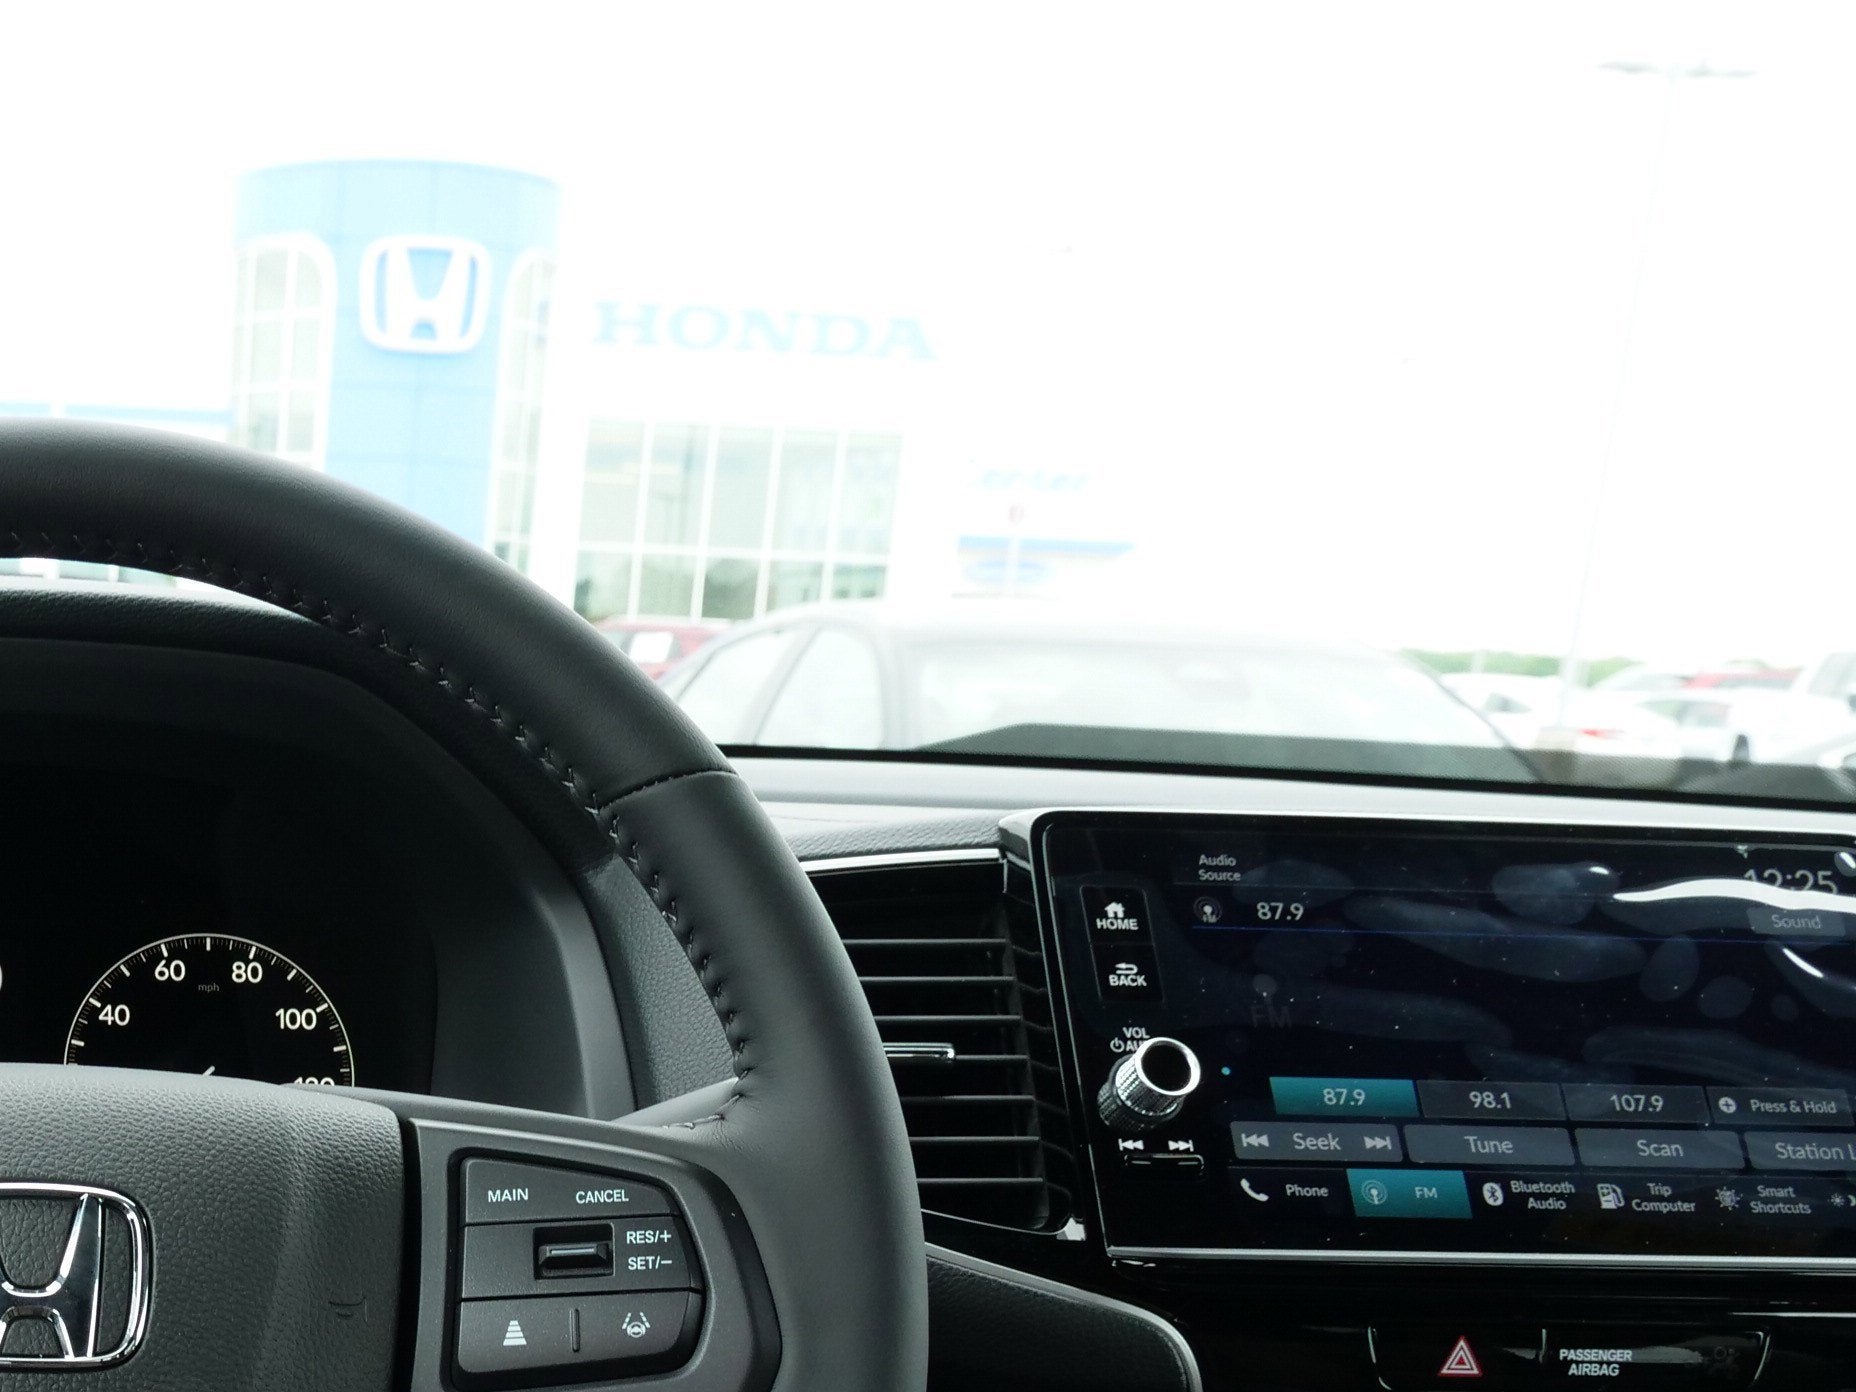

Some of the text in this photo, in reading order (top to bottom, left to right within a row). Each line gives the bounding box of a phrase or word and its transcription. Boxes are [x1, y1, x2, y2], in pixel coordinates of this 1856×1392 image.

[592, 299, 940, 362] HONDA
[1198, 853, 1237, 867] Audio
[1198, 868, 1242, 882] Source
[1256, 901, 1305, 921] 87.9
[1096, 917, 1139, 931] HOME
[1771, 914, 1822, 930] Sound
[154, 959, 185, 982] 60
[231, 961, 263, 984] 80
[198, 983, 220, 993] mph
[1108, 974, 1147, 988] BACK
[99, 1004, 130, 1027] 40
[275, 1008, 317, 1031] 100
[1122, 1026, 1150, 1039] VOL
[1323, 1089, 1365, 1107] 87.9
[1469, 1092, 1511, 1109] 98.1
[1610, 1095, 1663, 1113] 107.9
[1750, 1099, 1837, 1114] Press & Hold
[1292, 1132, 1341, 1151] Seek
[1464, 1136, 1513, 1154] Tune
[1637, 1139, 1683, 1157] Scan
[1775, 1142, 1845, 1160] Station
[1286, 1184, 1329, 1198] Phone
[1415, 1187, 1438, 1199] FM
[1510, 1180, 1575, 1194] Bluetooth
[1647, 1182, 1672, 1198] Trip
[1757, 1184, 1796, 1198] Smart
[487, 1188, 529, 1203] MAIN
[575, 1189, 630, 1204] CANCEL
[1528, 1197, 1566, 1211] Audio
[1632, 1199, 1696, 1214] Computer
[1750, 1200, 1812, 1214] Shortcuts
[626, 1229, 672, 1245] RES/+
[1559, 1348, 1633, 1362] PASSENGER
[1568, 1363, 1620, 1377] AIRBAG
